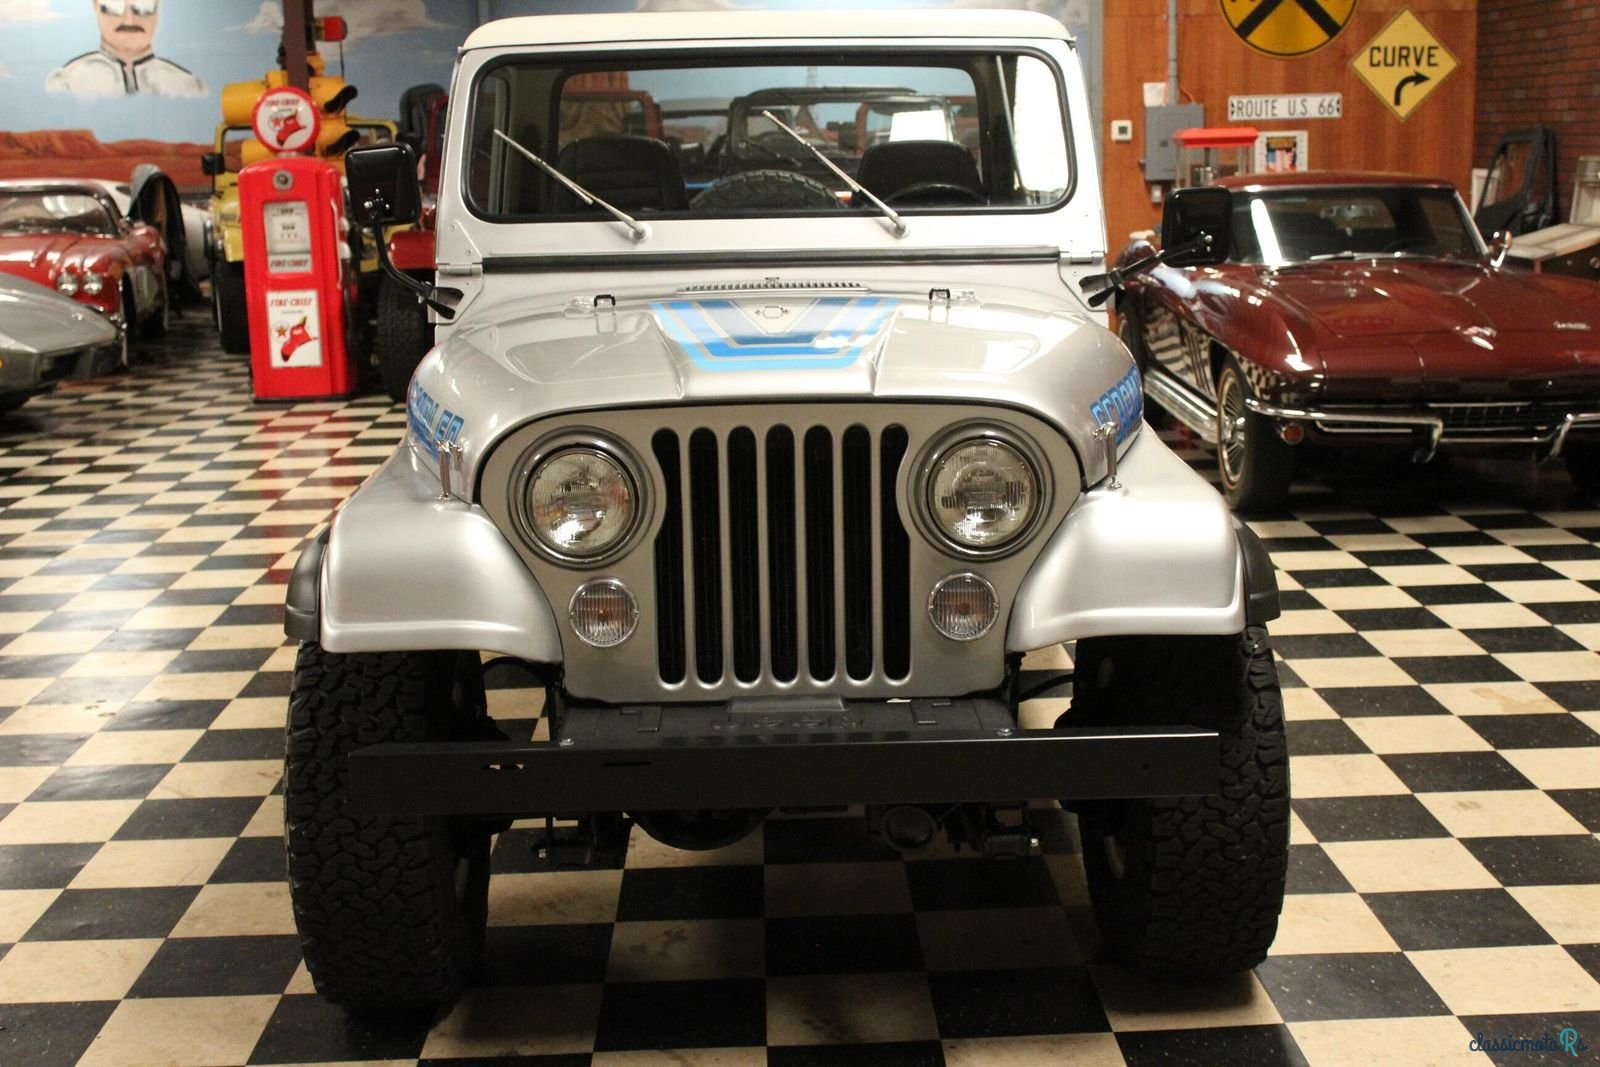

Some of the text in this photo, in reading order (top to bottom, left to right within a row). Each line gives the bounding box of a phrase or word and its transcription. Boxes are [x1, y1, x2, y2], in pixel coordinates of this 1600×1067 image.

[1369, 46, 1439, 67] CURVE
[1236, 100, 1278, 117] ROUTE
[1318, 97, 1335, 116] 66
